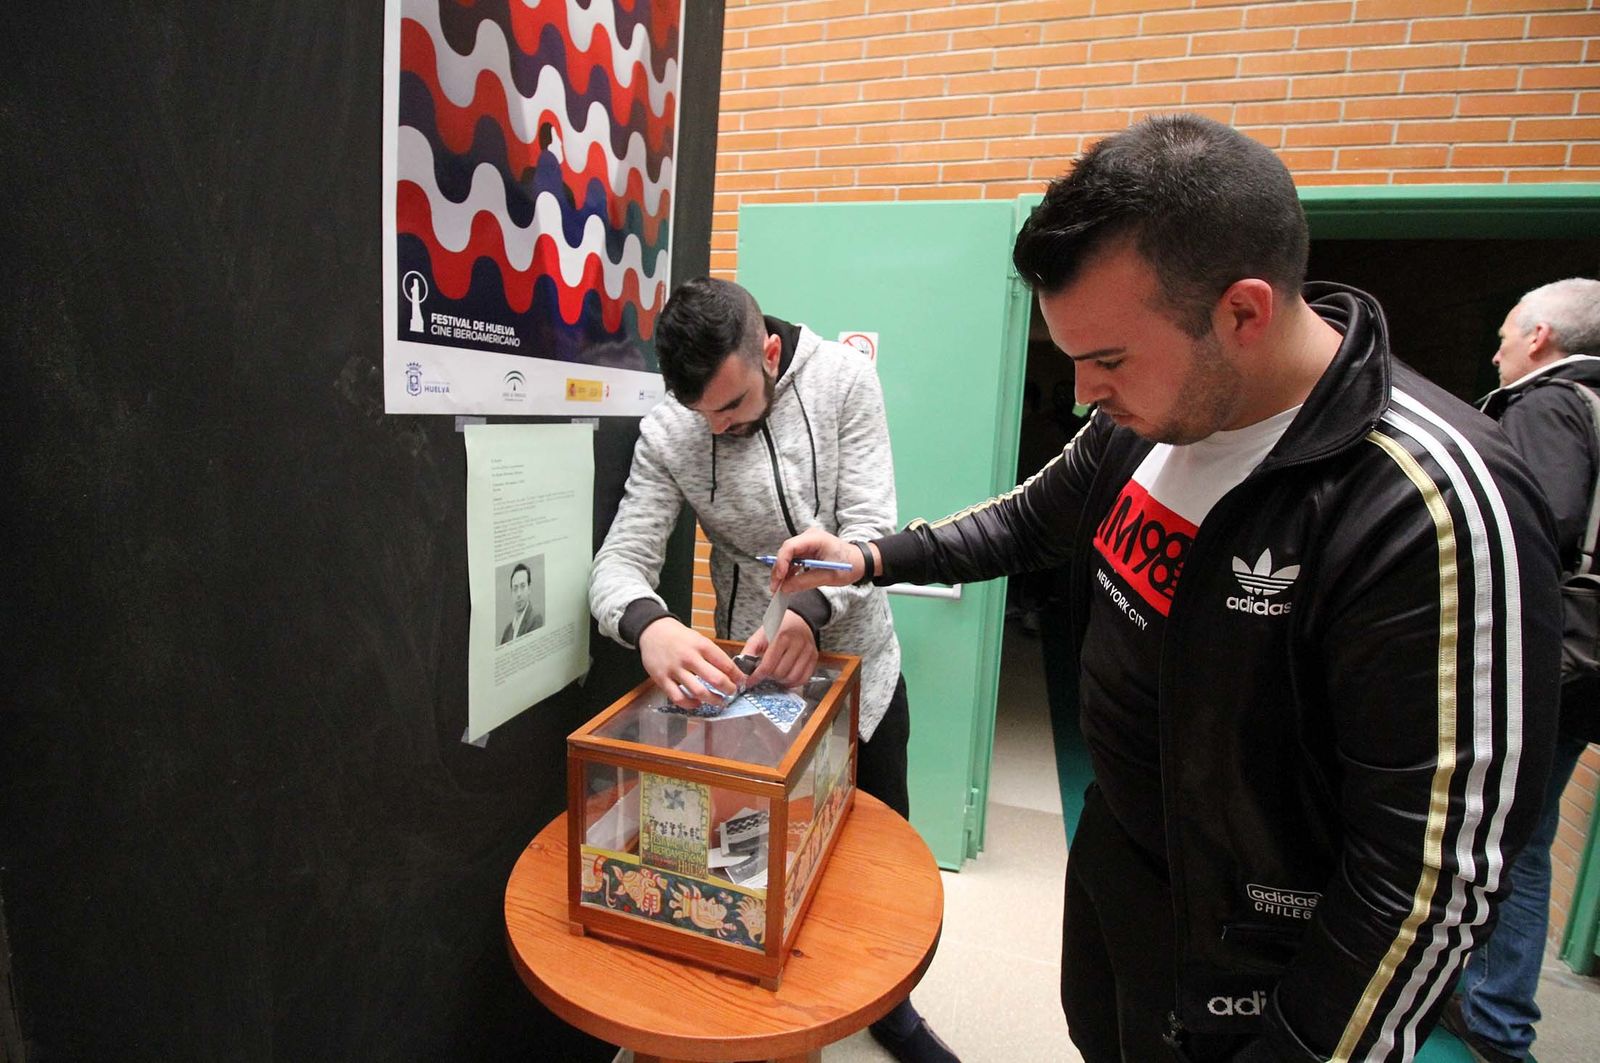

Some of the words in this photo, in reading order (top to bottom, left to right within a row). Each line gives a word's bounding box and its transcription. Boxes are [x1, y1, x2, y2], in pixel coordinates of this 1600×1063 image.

[430, 313, 472, 329] FESTIVAL
[473, 321, 485, 331] DE
[485, 323, 515, 336] HUELVA
[430, 325, 451, 337] CINE
[453, 328, 521, 347] IBEROAMERICANO
[424, 385, 450, 395] HUELVA
[1096, 568, 1112, 591] NEW
[1109, 585, 1130, 614] YORK
[1128, 608, 1148, 631] CITY
[1226, 595, 1292, 616] adidas
[1252, 889, 1318, 908] adidas
